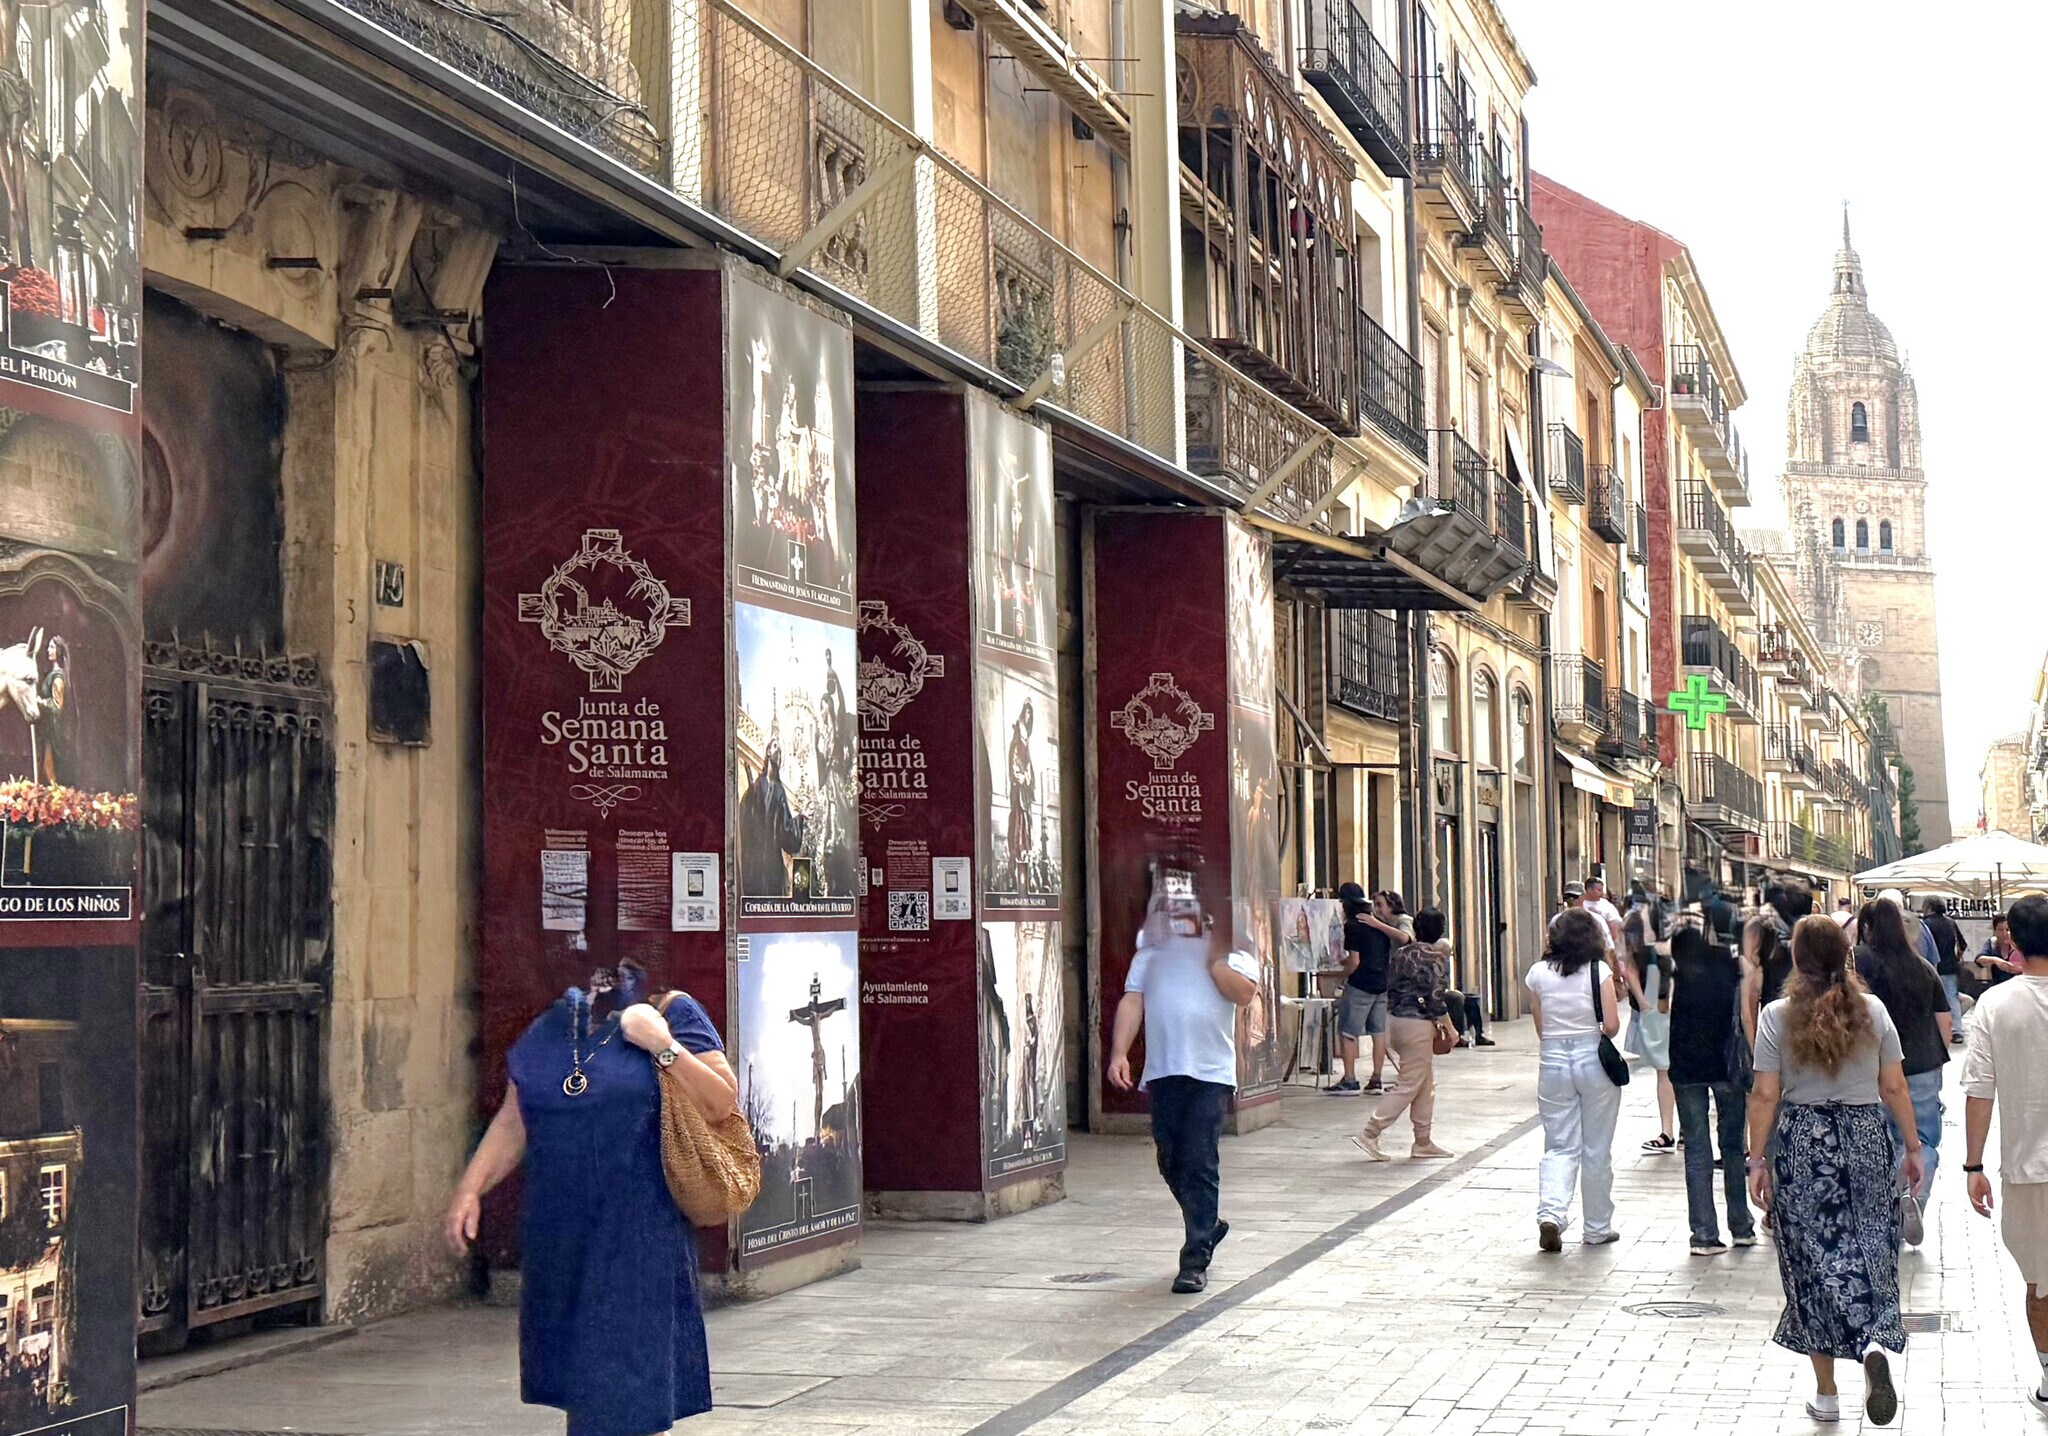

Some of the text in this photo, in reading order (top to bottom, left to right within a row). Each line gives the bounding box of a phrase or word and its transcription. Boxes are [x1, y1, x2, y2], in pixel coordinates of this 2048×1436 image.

[21, 359, 77, 389] PERDÓN
[577, 697, 660, 720] Junta de
[540, 711, 668, 745] Semana
[860, 733, 921, 750] unta de
[568, 740, 668, 773] Santa
[858, 751, 928, 769] mana
[589, 766, 668, 779] de Salamanca
[1147, 771, 1197, 786] Junta de
[864, 788, 928, 799] de Salamanca
[1125, 780, 1202, 801] Semana
[1142, 797, 1202, 818] Santa
[25, 898, 44, 912] DE
[47, 897, 74, 912] LOS
[78, 894, 120, 912] NIÑOS
[862, 981, 929, 994] Ayuntamiento
[863, 994, 929, 1004] de Salamanca
